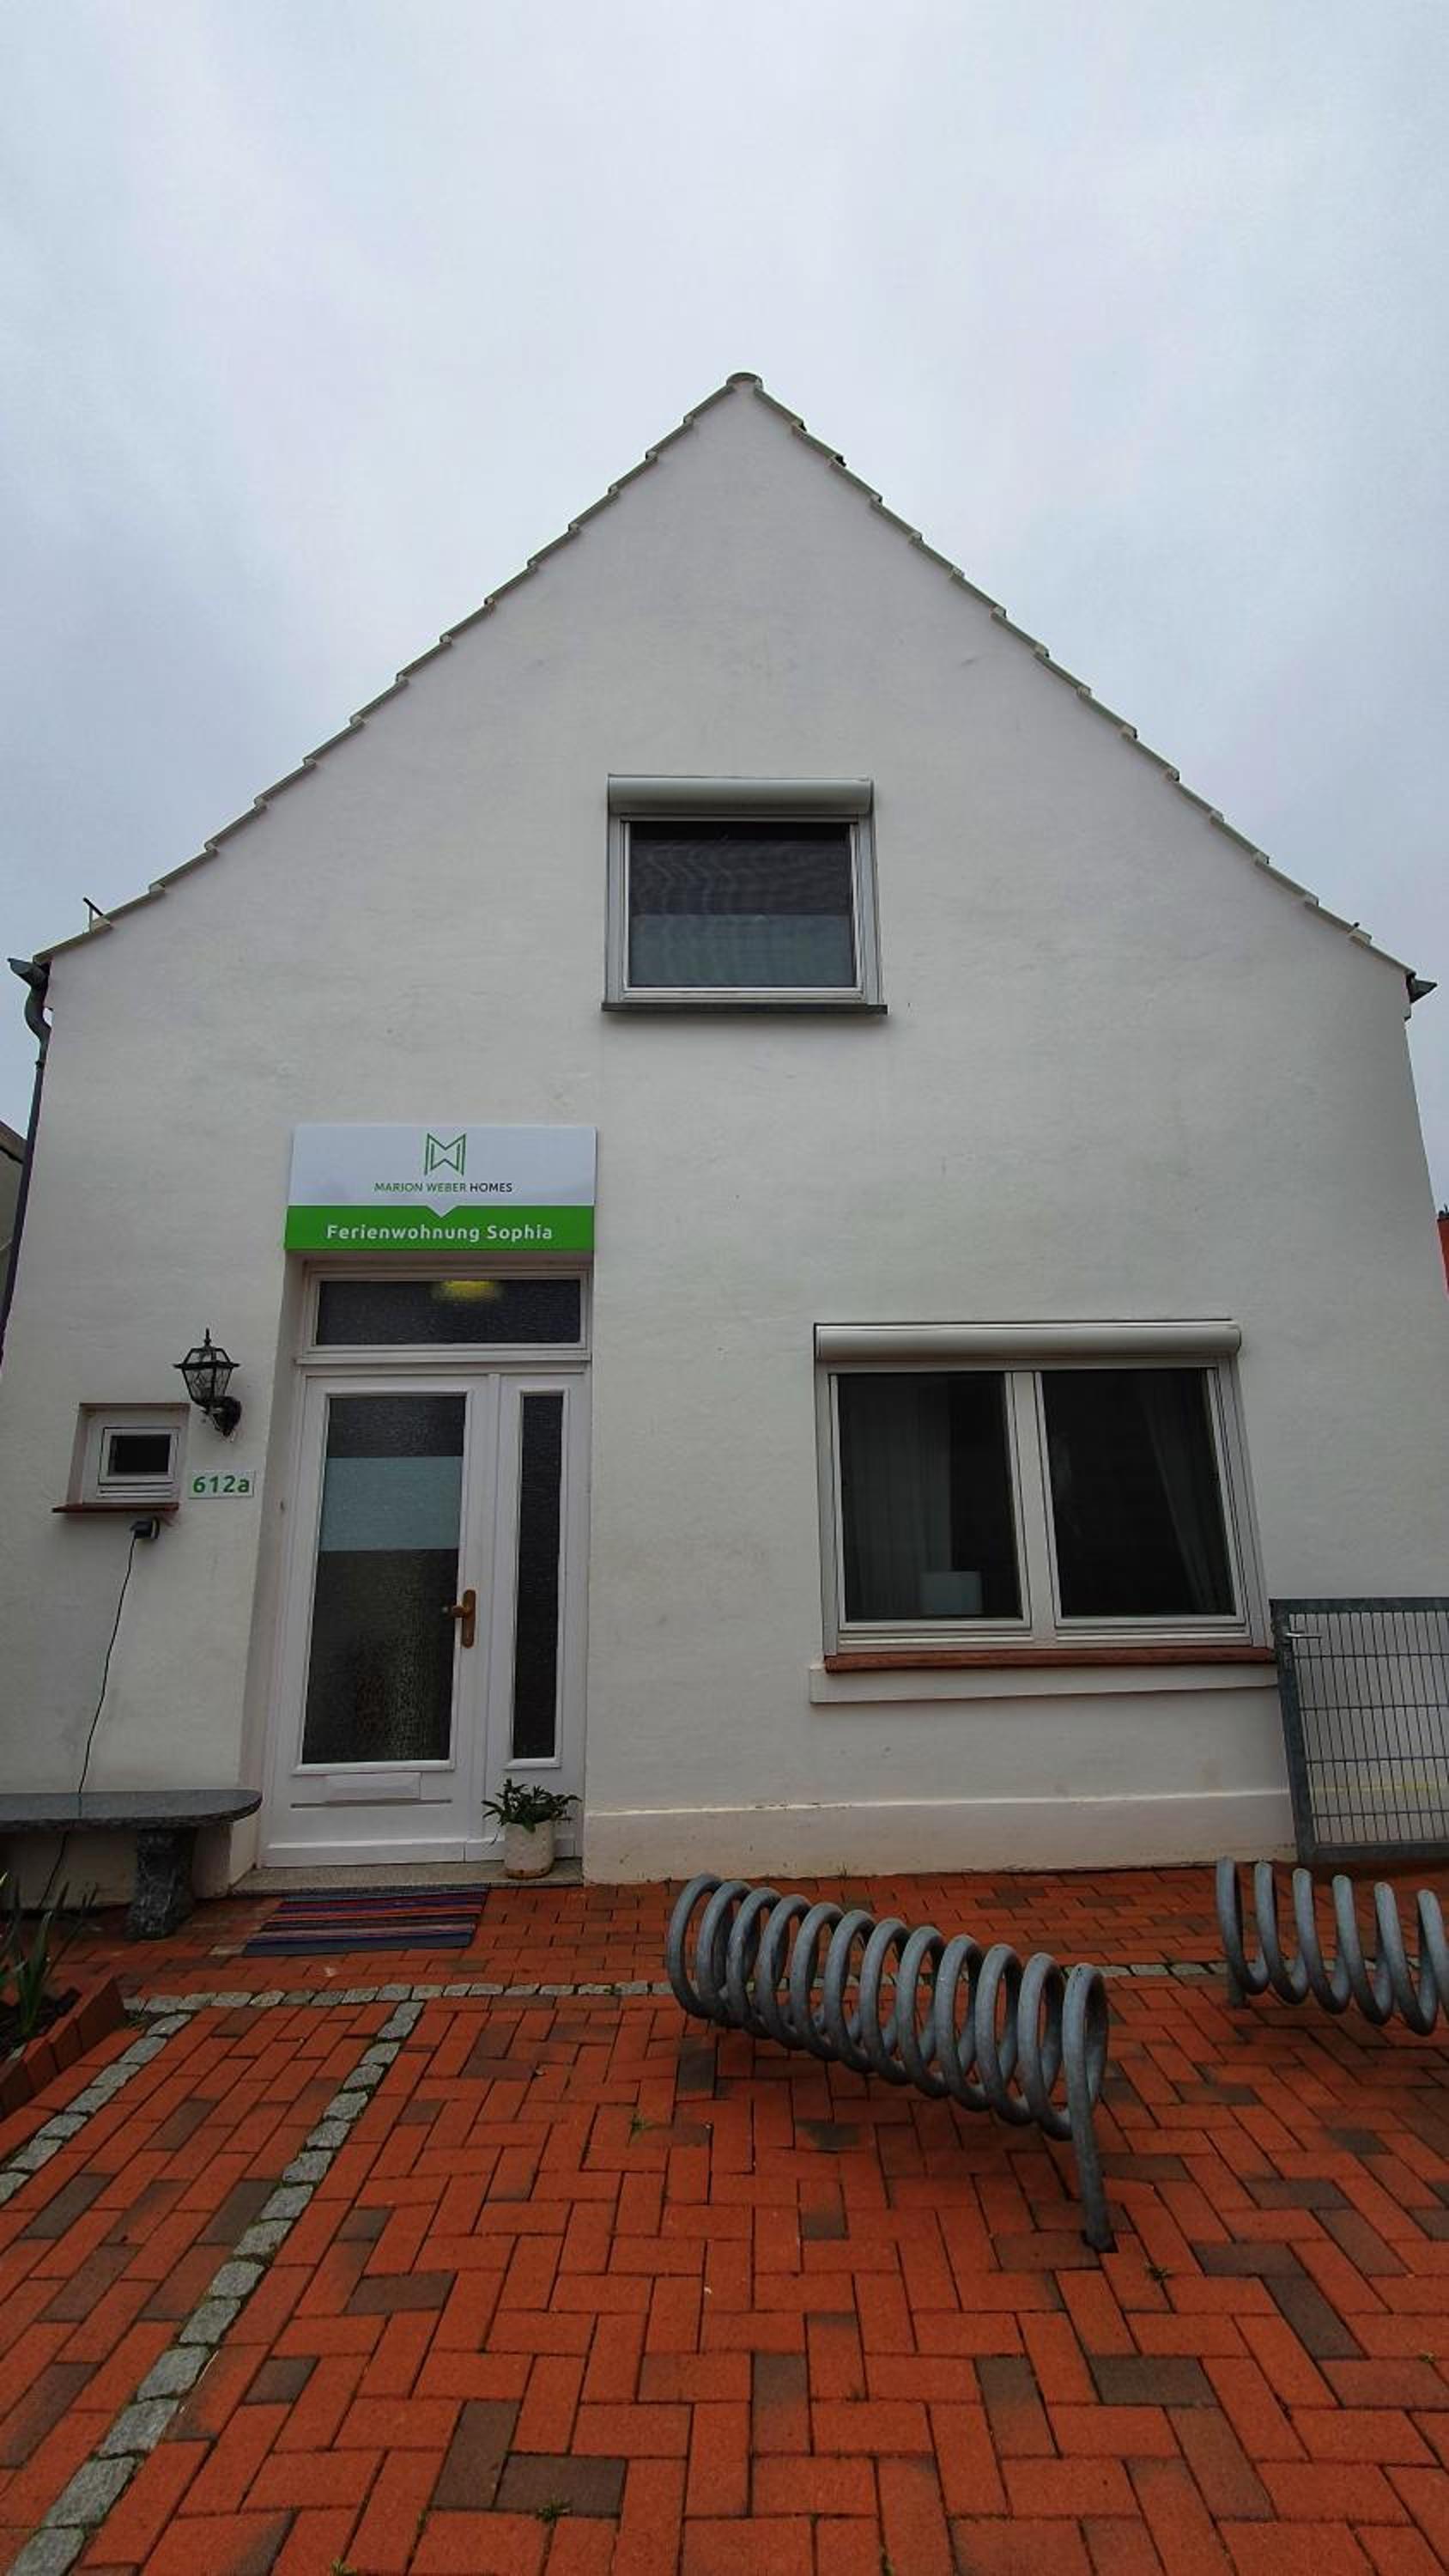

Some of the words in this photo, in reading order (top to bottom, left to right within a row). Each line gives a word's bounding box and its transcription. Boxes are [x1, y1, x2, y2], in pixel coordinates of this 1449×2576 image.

[374, 1182, 424, 1193] MARION
[427, 1182, 466, 1193] WEBER
[470, 1182, 512, 1193] HOMES
[326, 1224, 480, 1242] Ferienwohnung
[487, 1224, 553, 1242] Sophia
[193, 1475, 250, 1493] 612a
